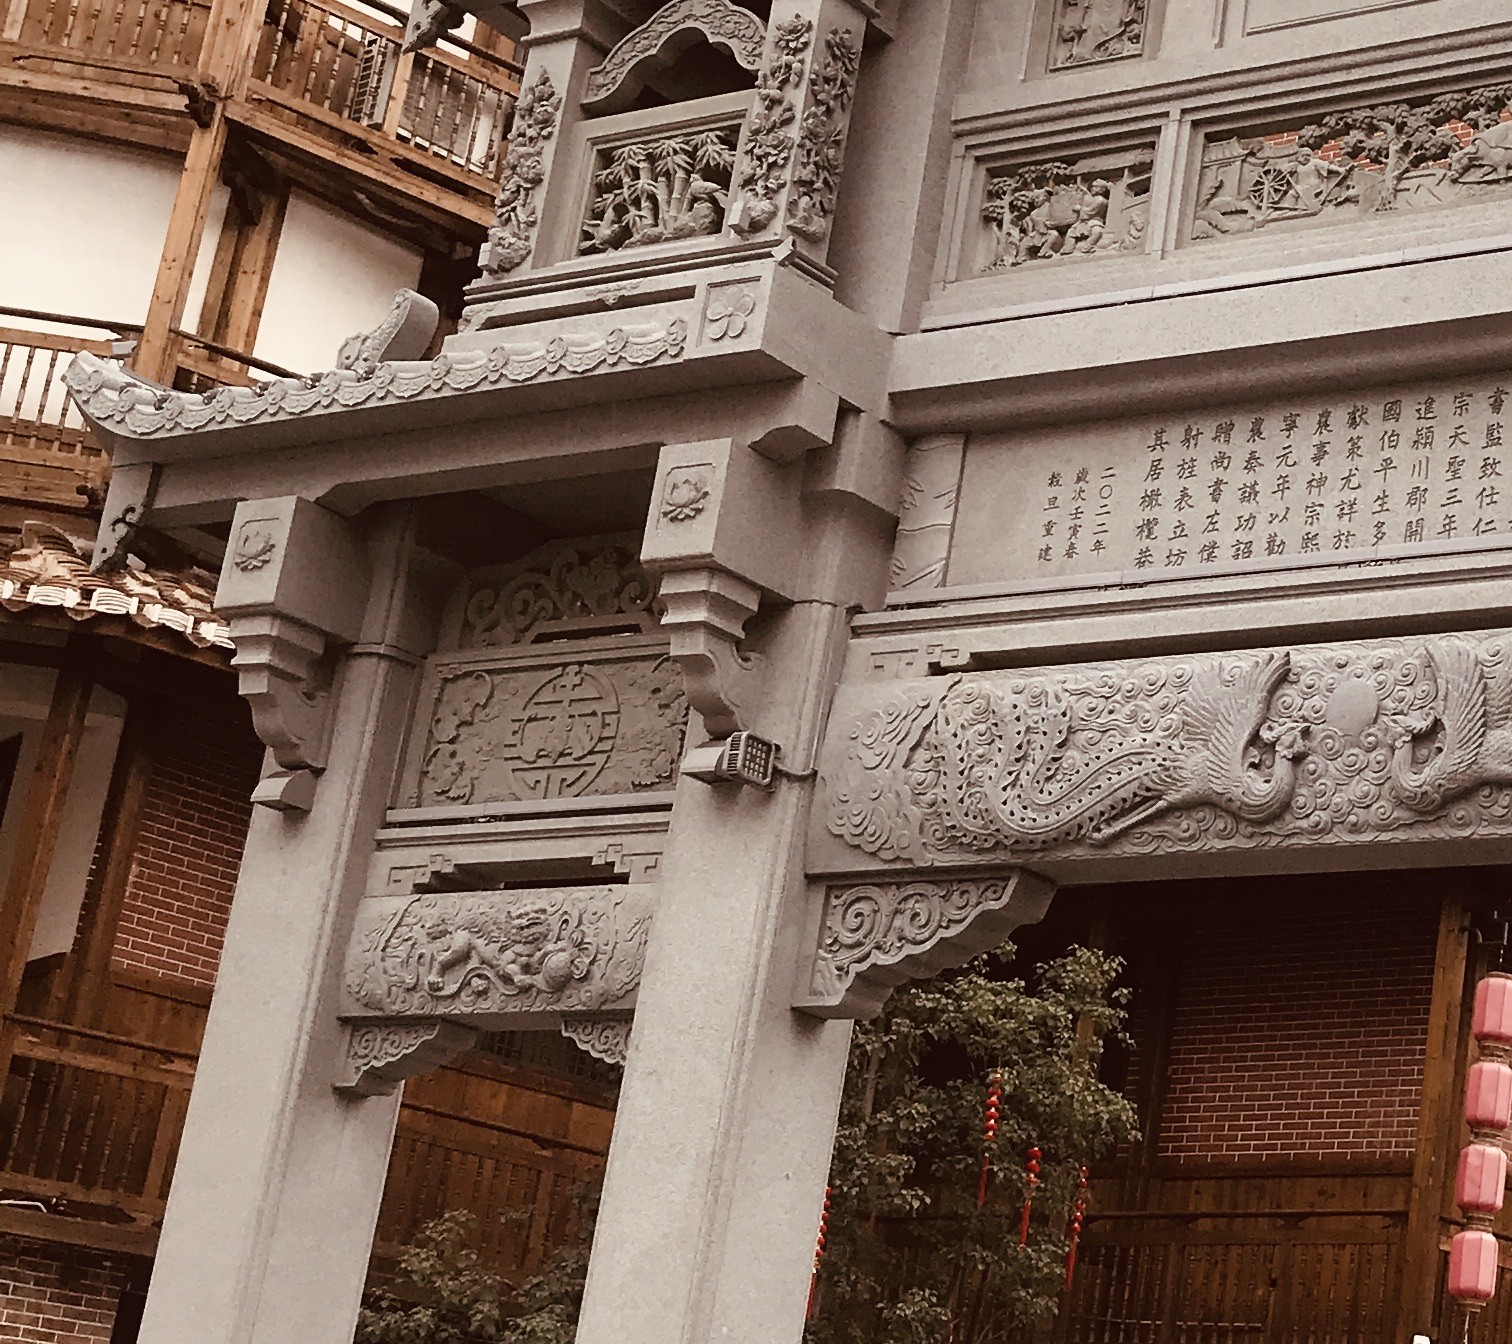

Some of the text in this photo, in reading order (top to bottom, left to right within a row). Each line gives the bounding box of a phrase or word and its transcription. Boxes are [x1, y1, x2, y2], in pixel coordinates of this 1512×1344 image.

[1371, 399, 1403, 546] 國伯平生多
[1436, 391, 1473, 539] 宗天聖三年
